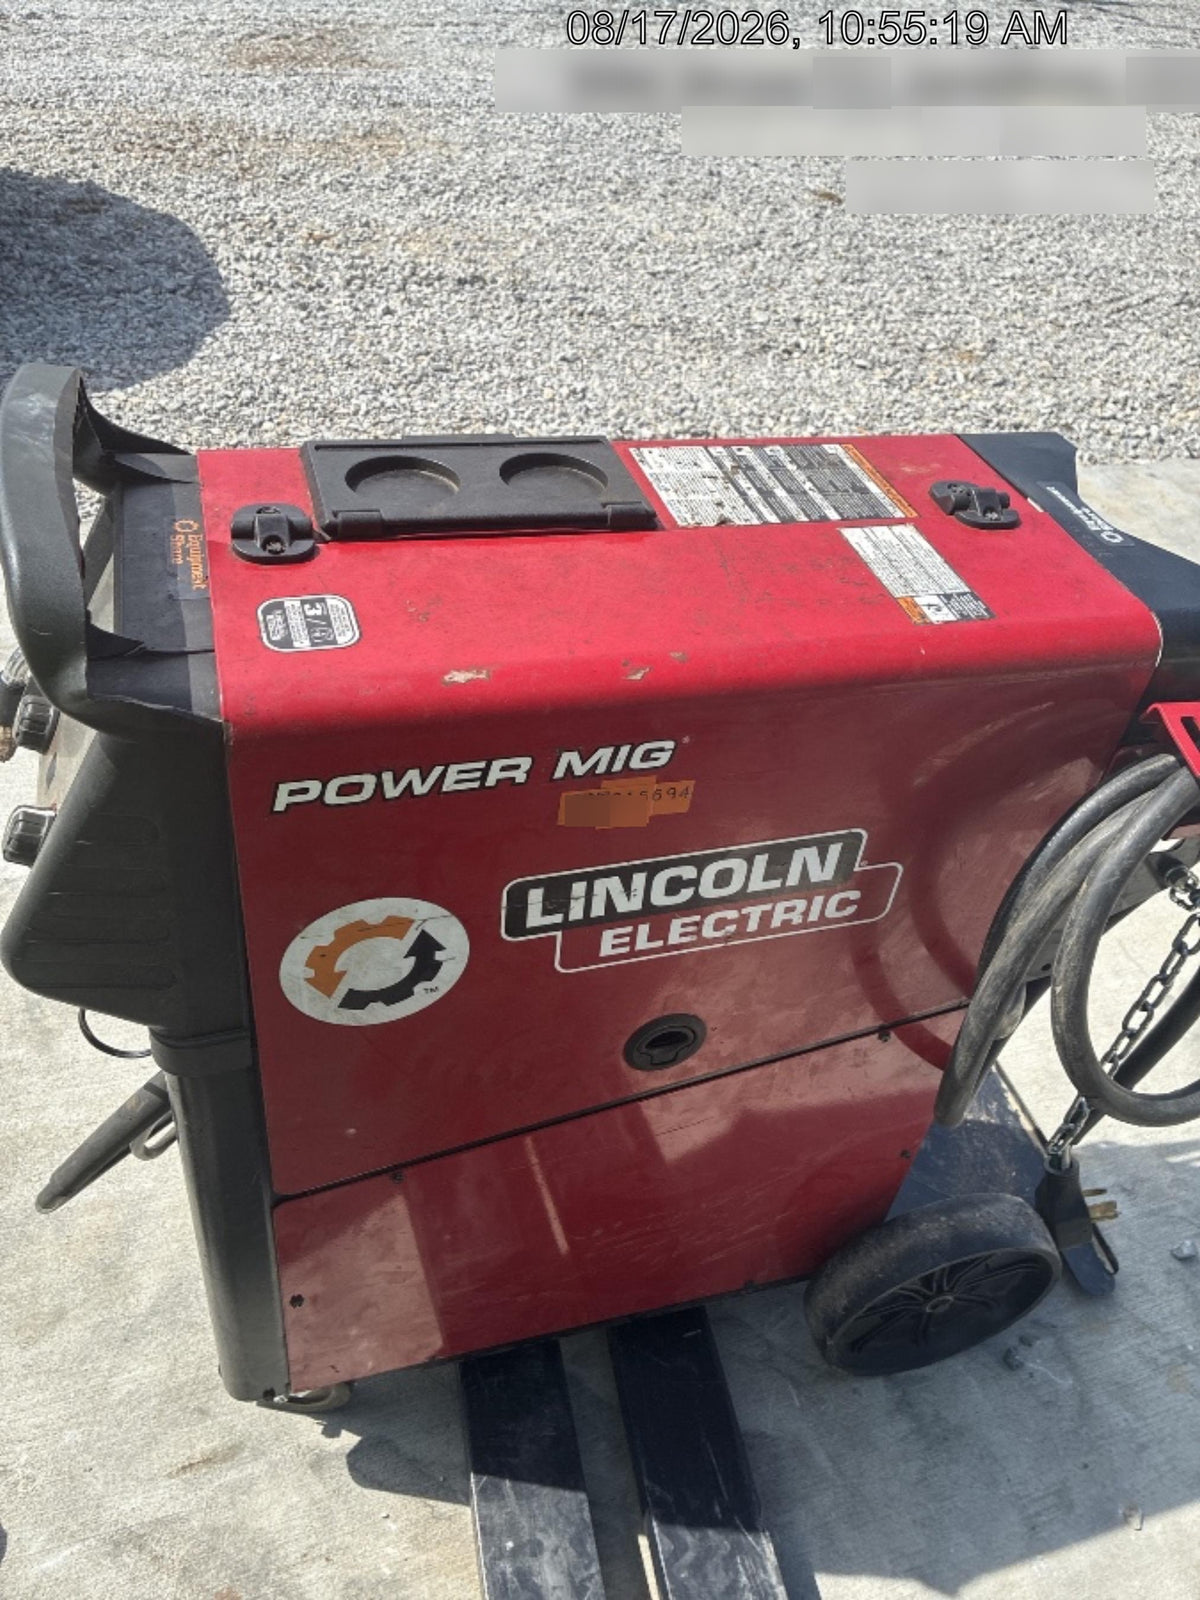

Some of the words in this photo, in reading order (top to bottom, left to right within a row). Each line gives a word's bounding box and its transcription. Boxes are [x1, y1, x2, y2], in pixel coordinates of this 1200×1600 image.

[271, 756, 533, 813] POWER
[551, 739, 676, 781] MIG
[525, 842, 844, 928] LINCOLN
[598, 889, 862, 958] ELECTRIC
